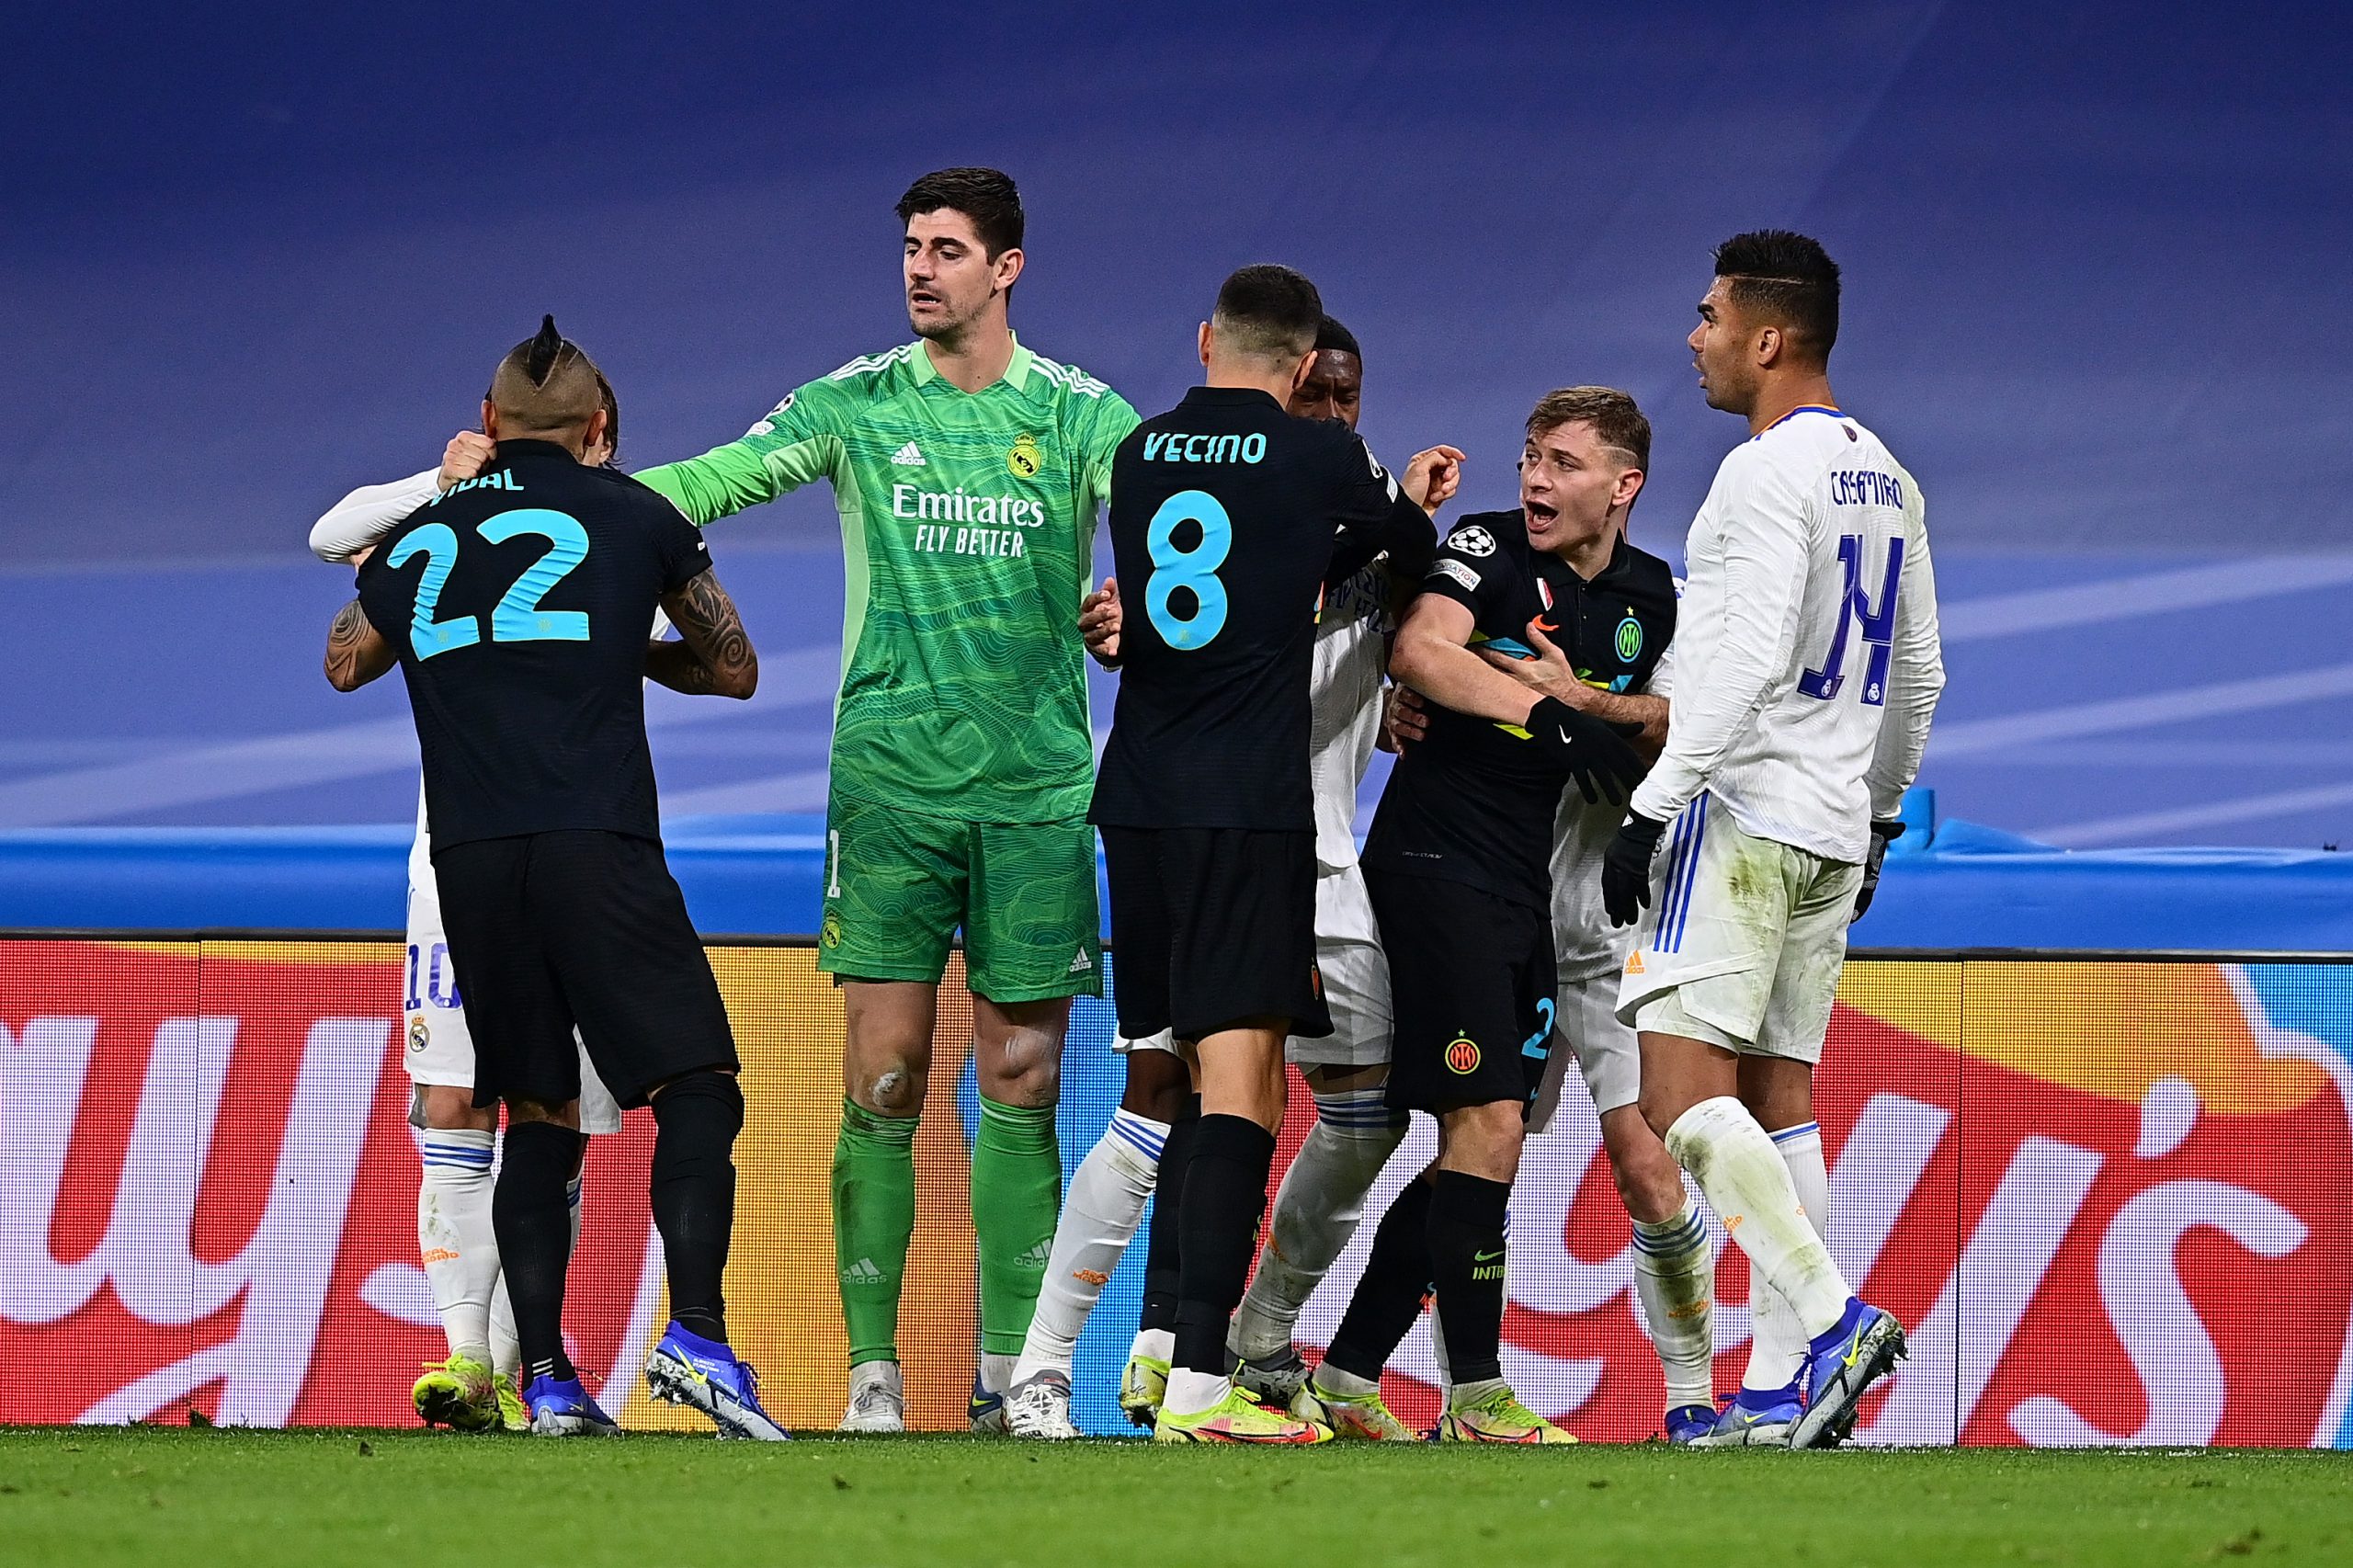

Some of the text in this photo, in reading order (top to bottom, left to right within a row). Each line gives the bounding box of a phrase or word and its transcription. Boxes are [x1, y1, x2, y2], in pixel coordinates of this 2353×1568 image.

[890, 455, 926, 466] adidas
[1143, 432, 1267, 464] VECINO
[892, 483, 1045, 528] Emirates
[915, 524, 1024, 558] FLY BETTER
[1145, 490, 1233, 651] 8
[386, 508, 591, 662] 22
[1796, 534, 1904, 707] 14
[827, 829, 841, 899] 1
[405, 942, 463, 1011] 10
[1521, 997, 1555, 1060] 2
[1014, 1256, 1050, 1268] adid
